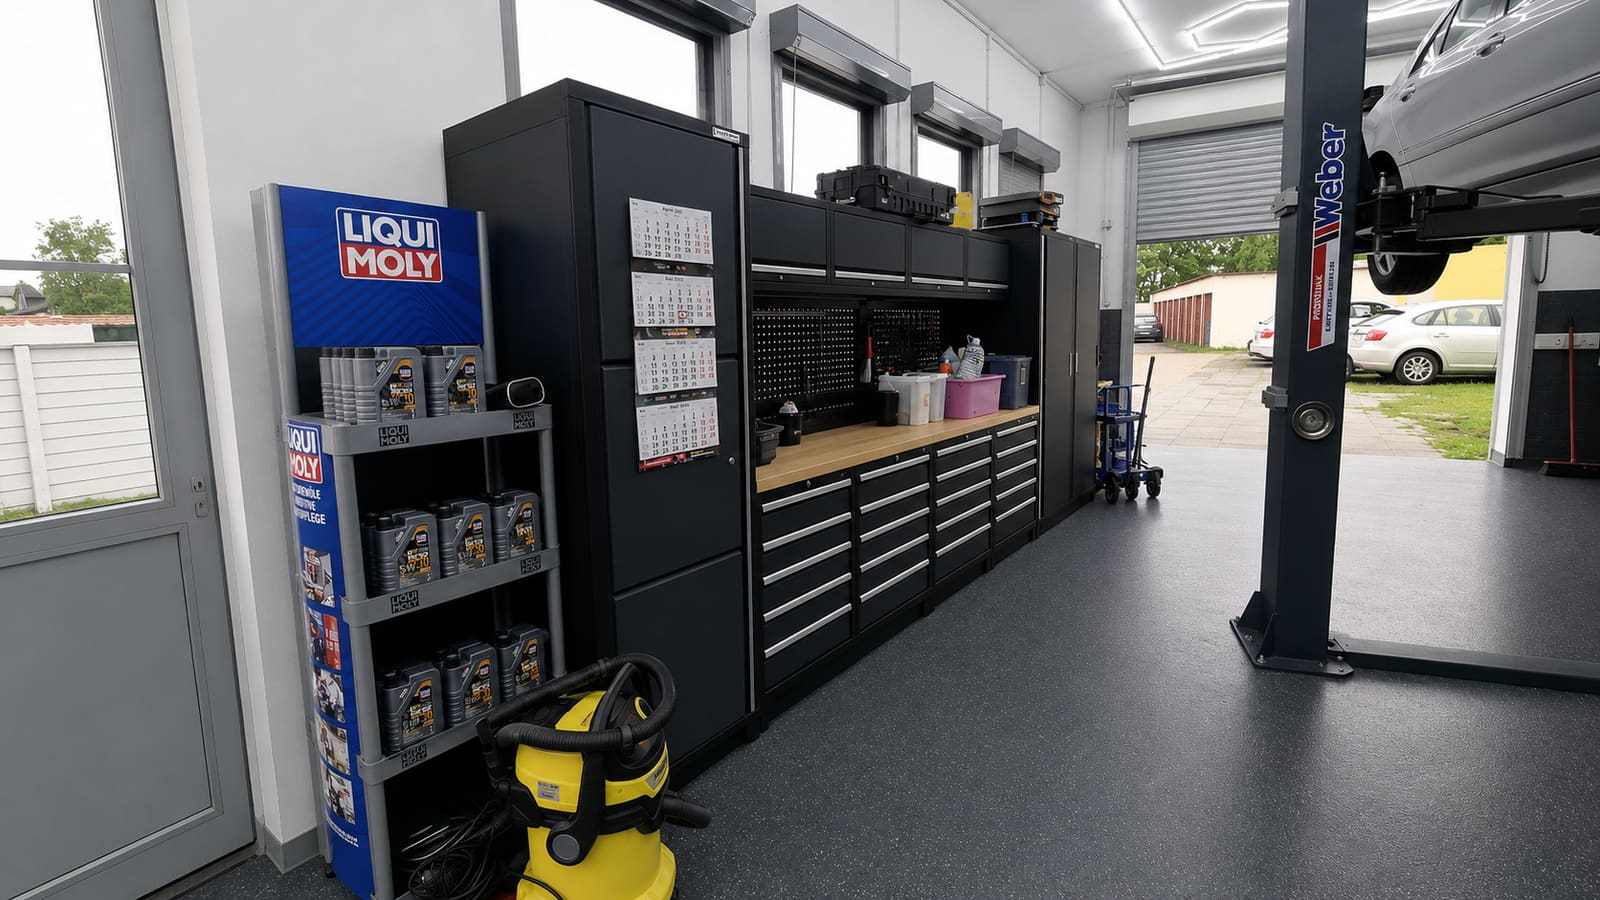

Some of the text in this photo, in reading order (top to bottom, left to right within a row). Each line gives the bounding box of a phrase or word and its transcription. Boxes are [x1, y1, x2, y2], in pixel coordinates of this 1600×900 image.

[1313, 122, 1345, 231] Weber
[343, 212, 435, 248] LIQUI
[346, 247, 439, 278] MOLY
[379, 425, 408, 437] LIQUI
[380, 434, 409, 445] MOLY
